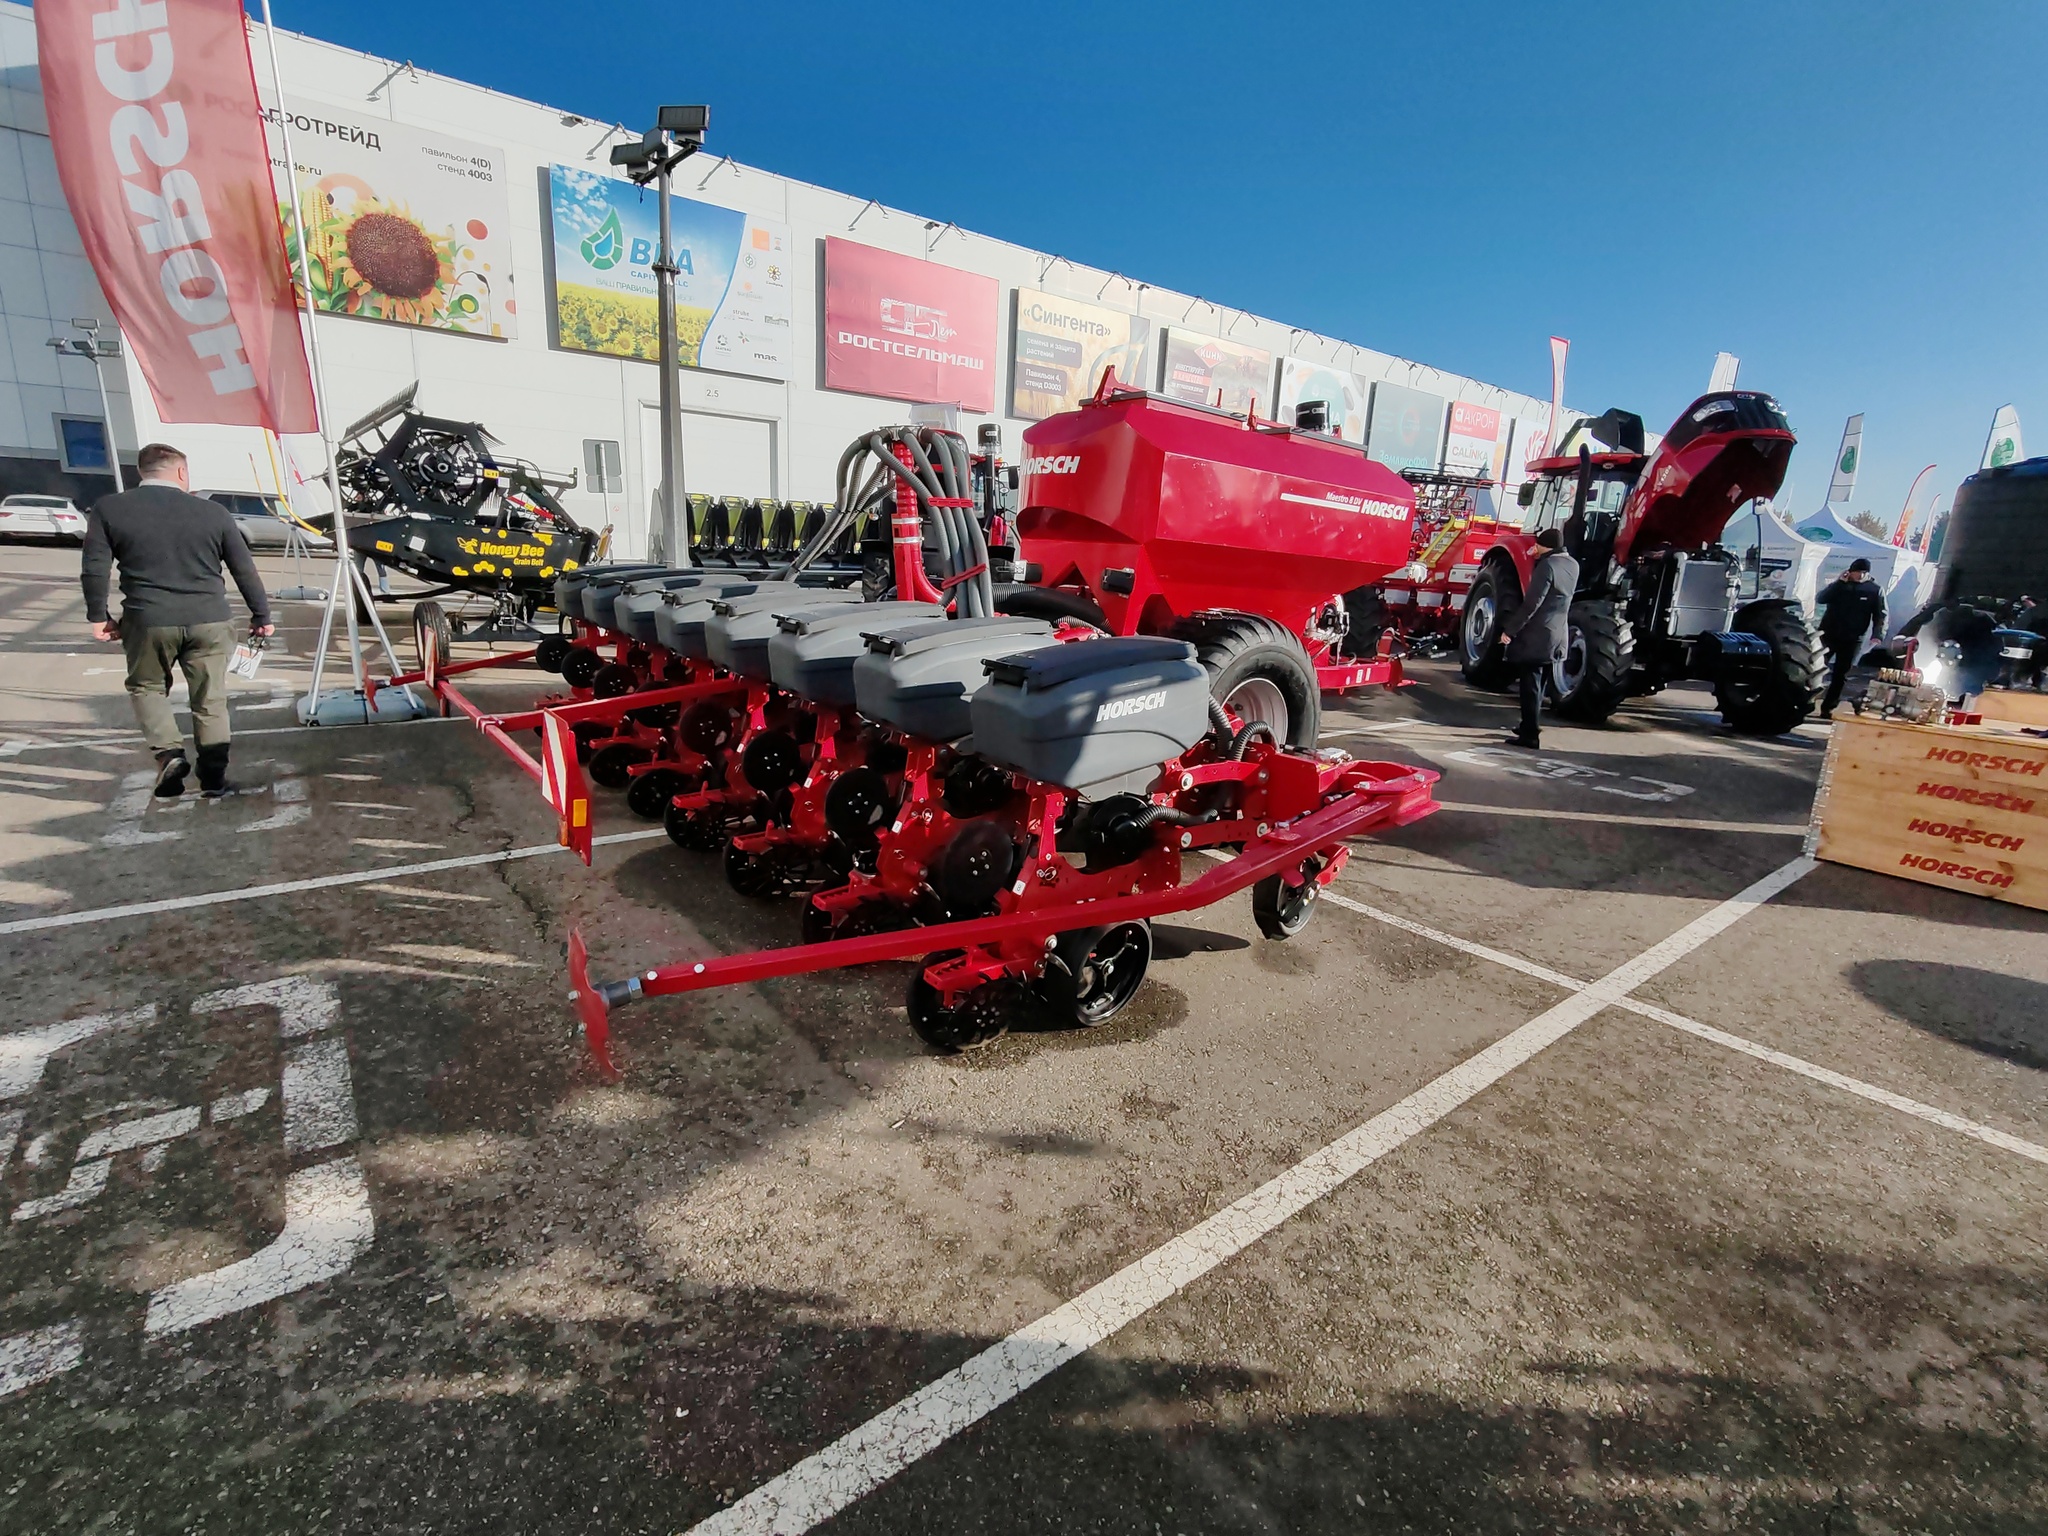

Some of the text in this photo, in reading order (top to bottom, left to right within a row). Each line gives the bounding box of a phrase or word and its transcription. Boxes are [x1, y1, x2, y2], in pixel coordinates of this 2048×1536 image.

[421, 146, 492, 171] павильон 4(D)
[437, 163, 493, 182] стенд 4003
[1023, 303, 1111, 337] «Сингента»
[838, 331, 984, 370] РОСТСЕЛЬМАШ
[1026, 337, 1050, 348] семена
[1055, 343, 1077, 355] защита
[1026, 347, 1055, 359] растений
[1200, 348, 1222, 361] KUHN
[753, 352, 778, 362] mas
[1025, 368, 1055, 380] Павильон
[706, 389, 719, 398] 2.5
[1025, 380, 1062, 392] стенд D3003
[1463, 409, 1495, 430] АКРОН
[1022, 456, 1081, 475] HORSCH
[1325, 492, 1349, 505] Maestro
[1361, 499, 1410, 521] HORSCH
[479, 541, 545, 558] Honey Bee
[513, 558, 531, 566] Grain
[1095, 690, 1168, 723] HORSCH
[1925, 746, 2045, 776] HORSCH
[1916, 782, 2035, 813] HORSCH
[1907, 818, 2025, 852] HORSCH
[1899, 853, 2015, 889] HORSCH
